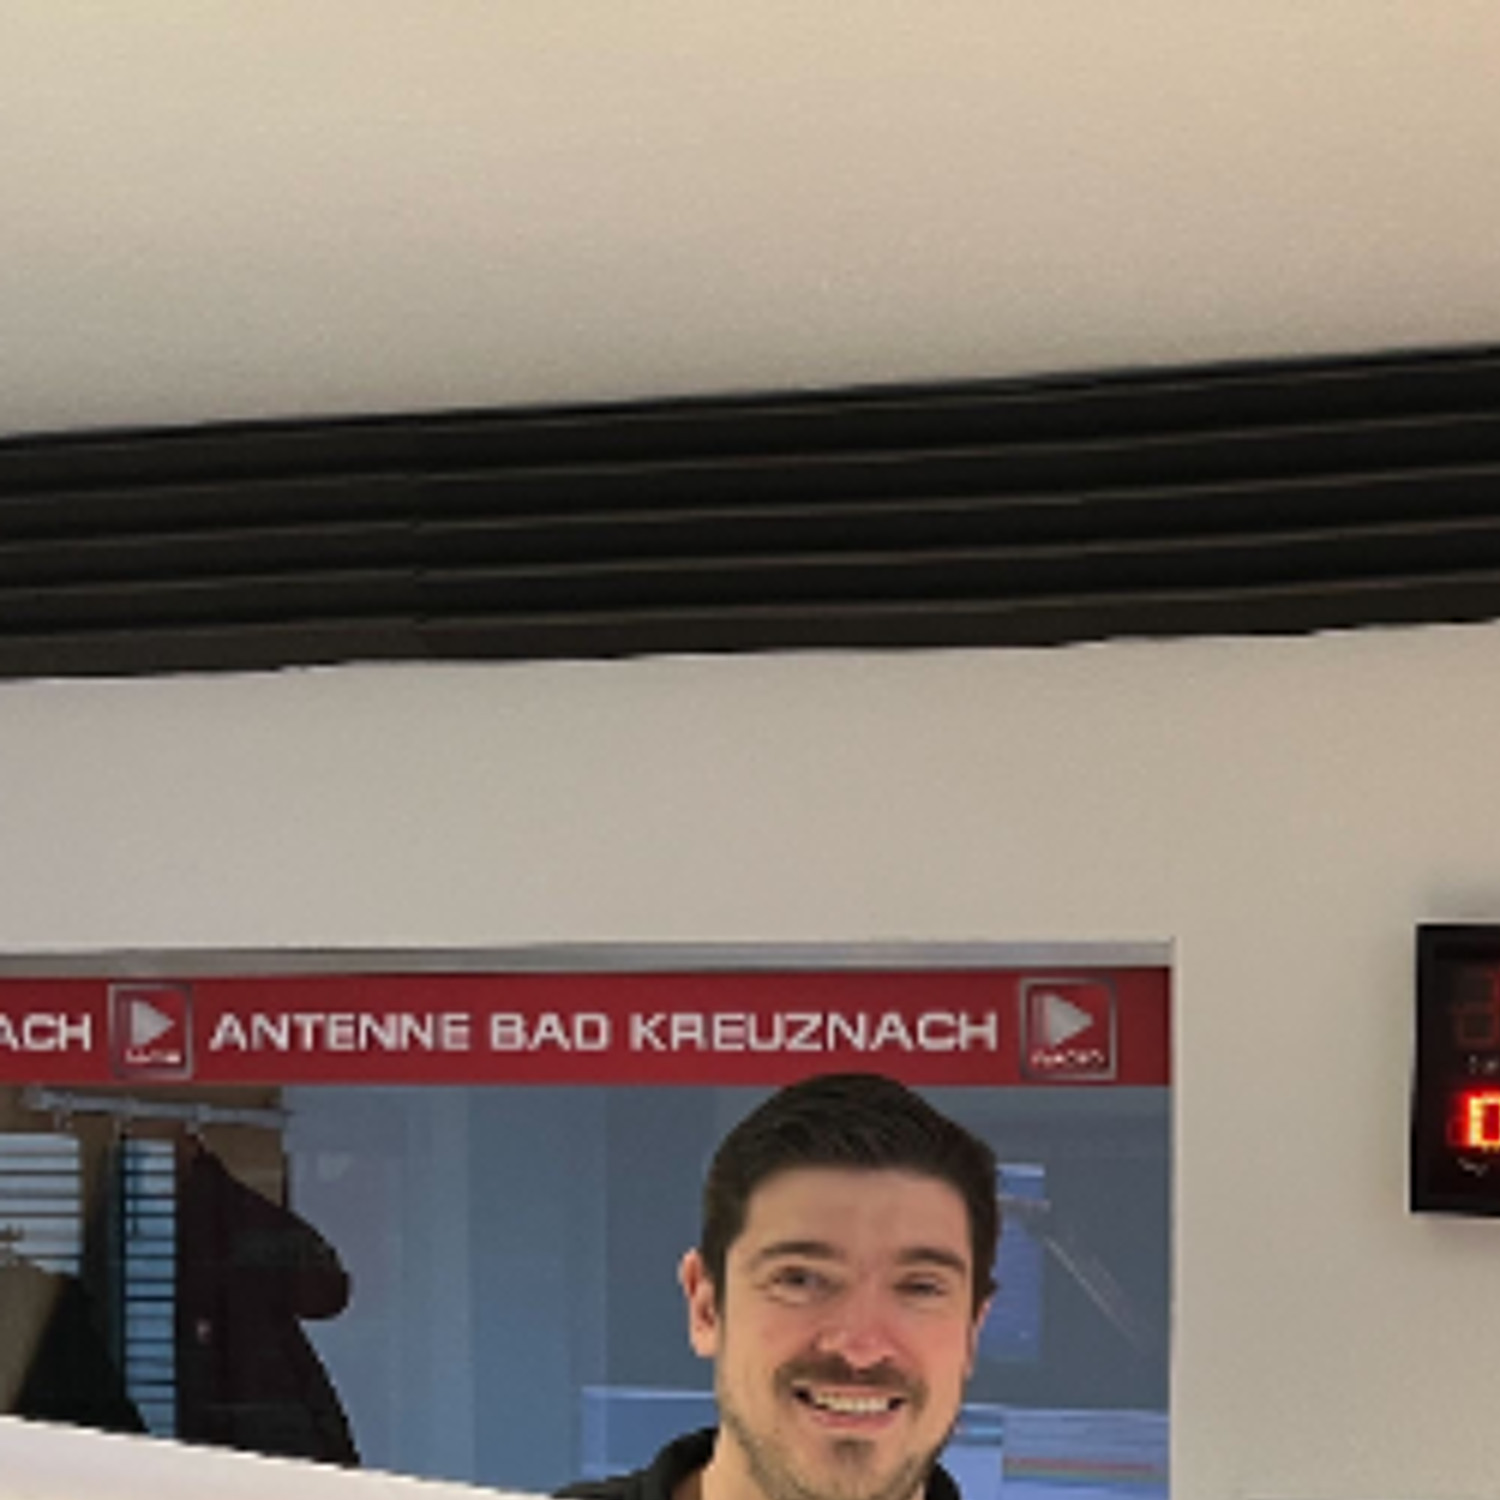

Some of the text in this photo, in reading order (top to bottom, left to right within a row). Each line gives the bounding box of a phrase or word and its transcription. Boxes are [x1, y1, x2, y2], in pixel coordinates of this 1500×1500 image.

[208, 1012, 998, 1052] ANTENNE BAD KREUZNACH
